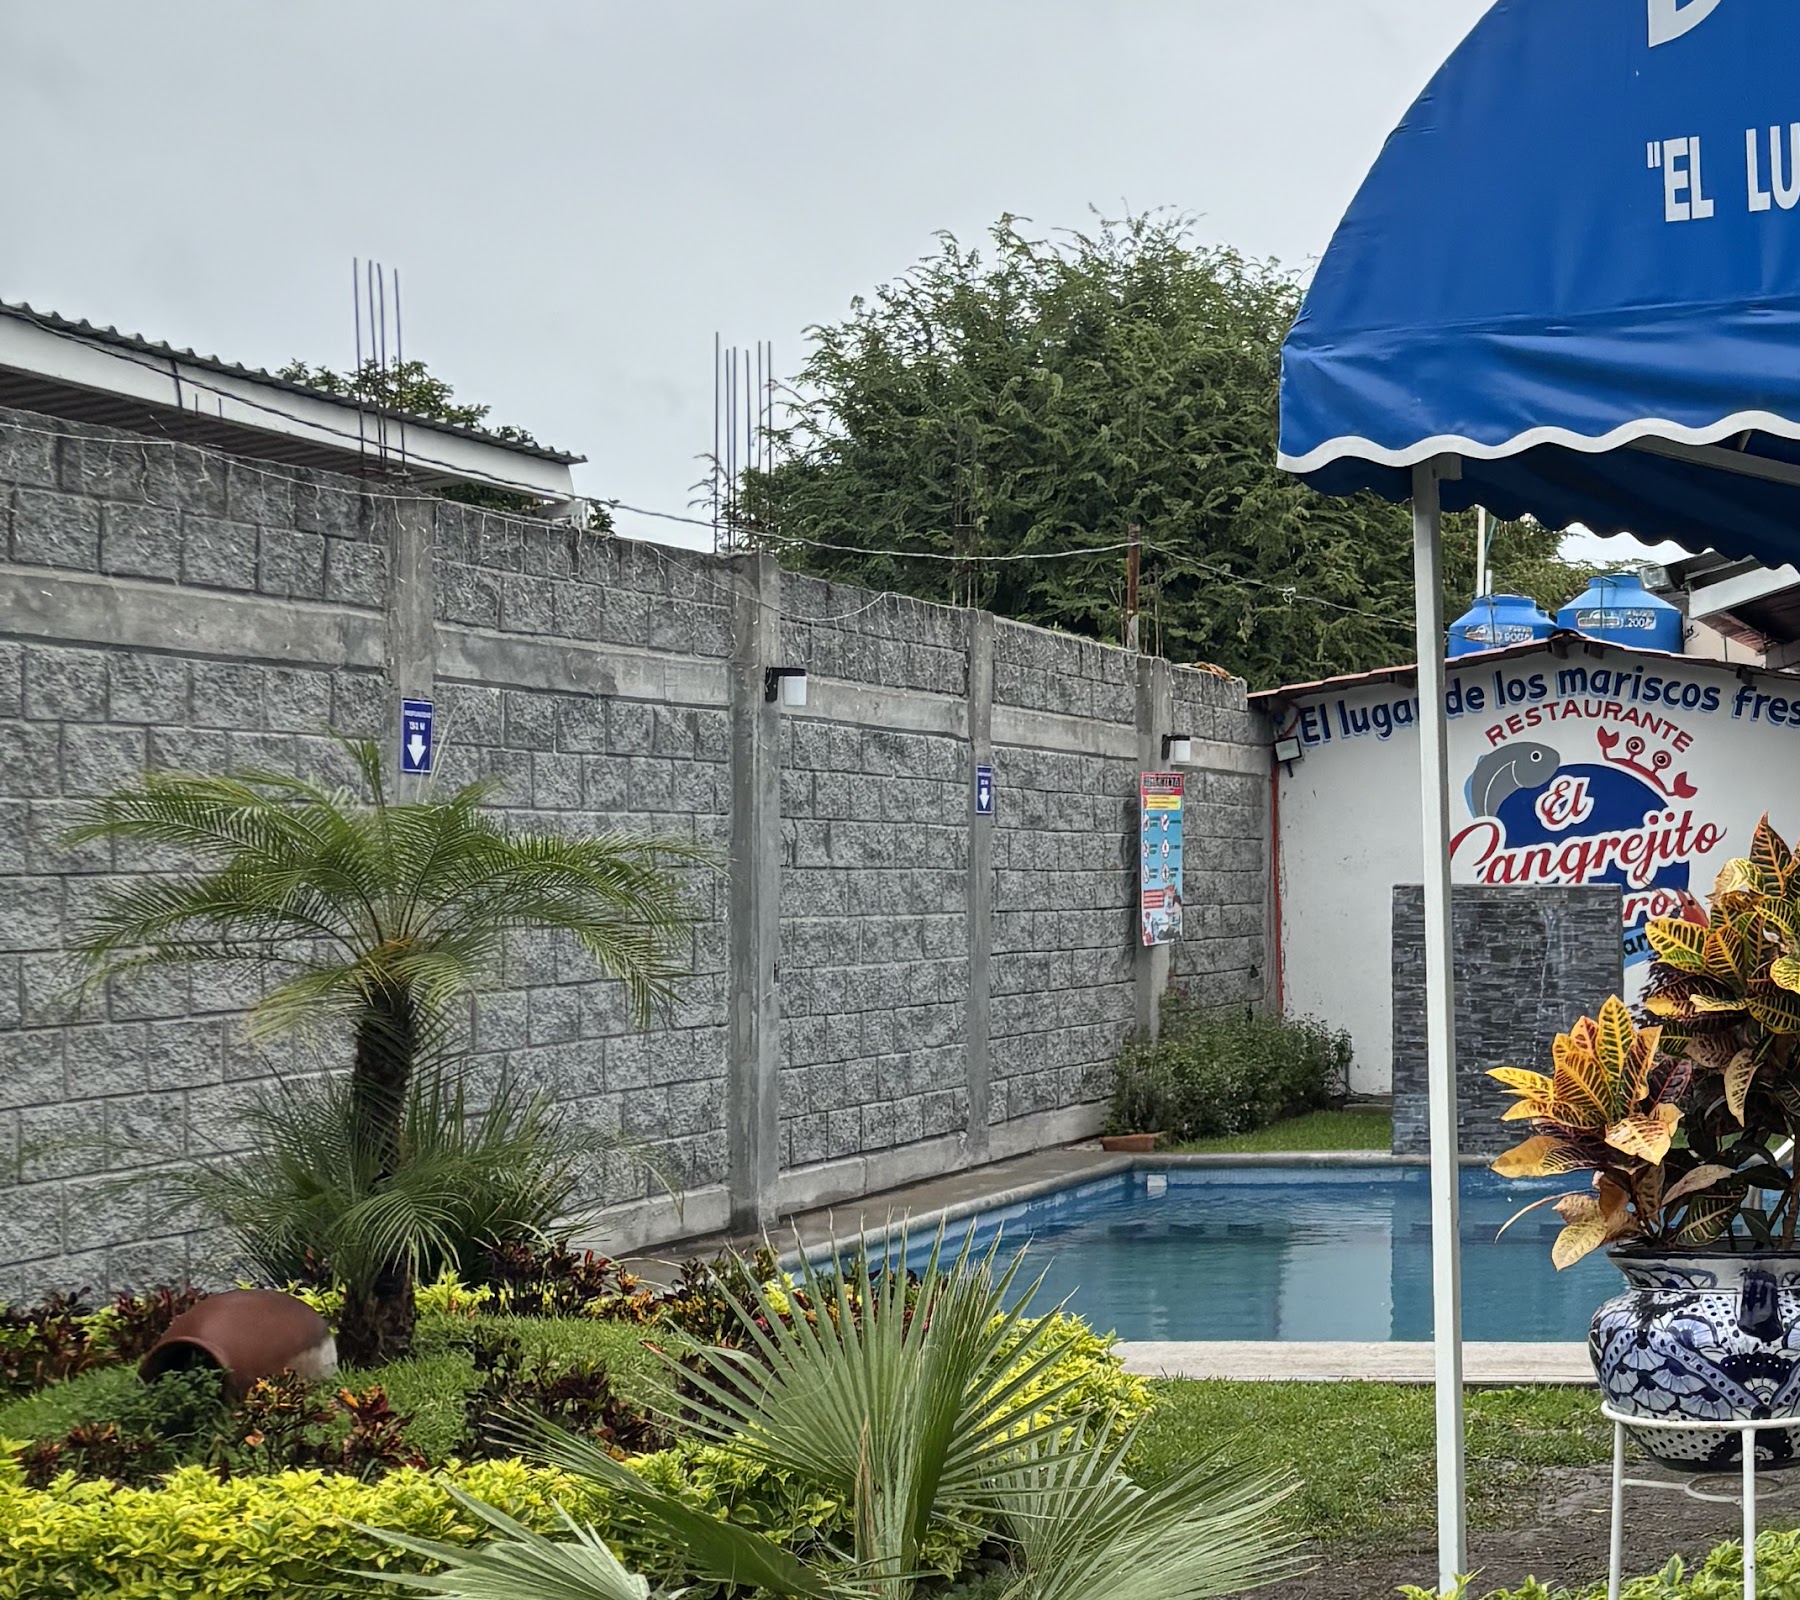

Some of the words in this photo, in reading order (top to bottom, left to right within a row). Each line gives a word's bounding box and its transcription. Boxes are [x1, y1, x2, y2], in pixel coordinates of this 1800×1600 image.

[1647, 136, 1714, 222] "EL
[1300, 702, 1332, 746] El
[1446, 677, 1485, 717] de
[1493, 669, 1549, 709] los
[1556, 664, 1720, 712] mariscos
[1484, 699, 1695, 753] RESTAURANTE
[1541, 779, 1588, 826] El
[1448, 809, 1728, 884] Cangrejito
